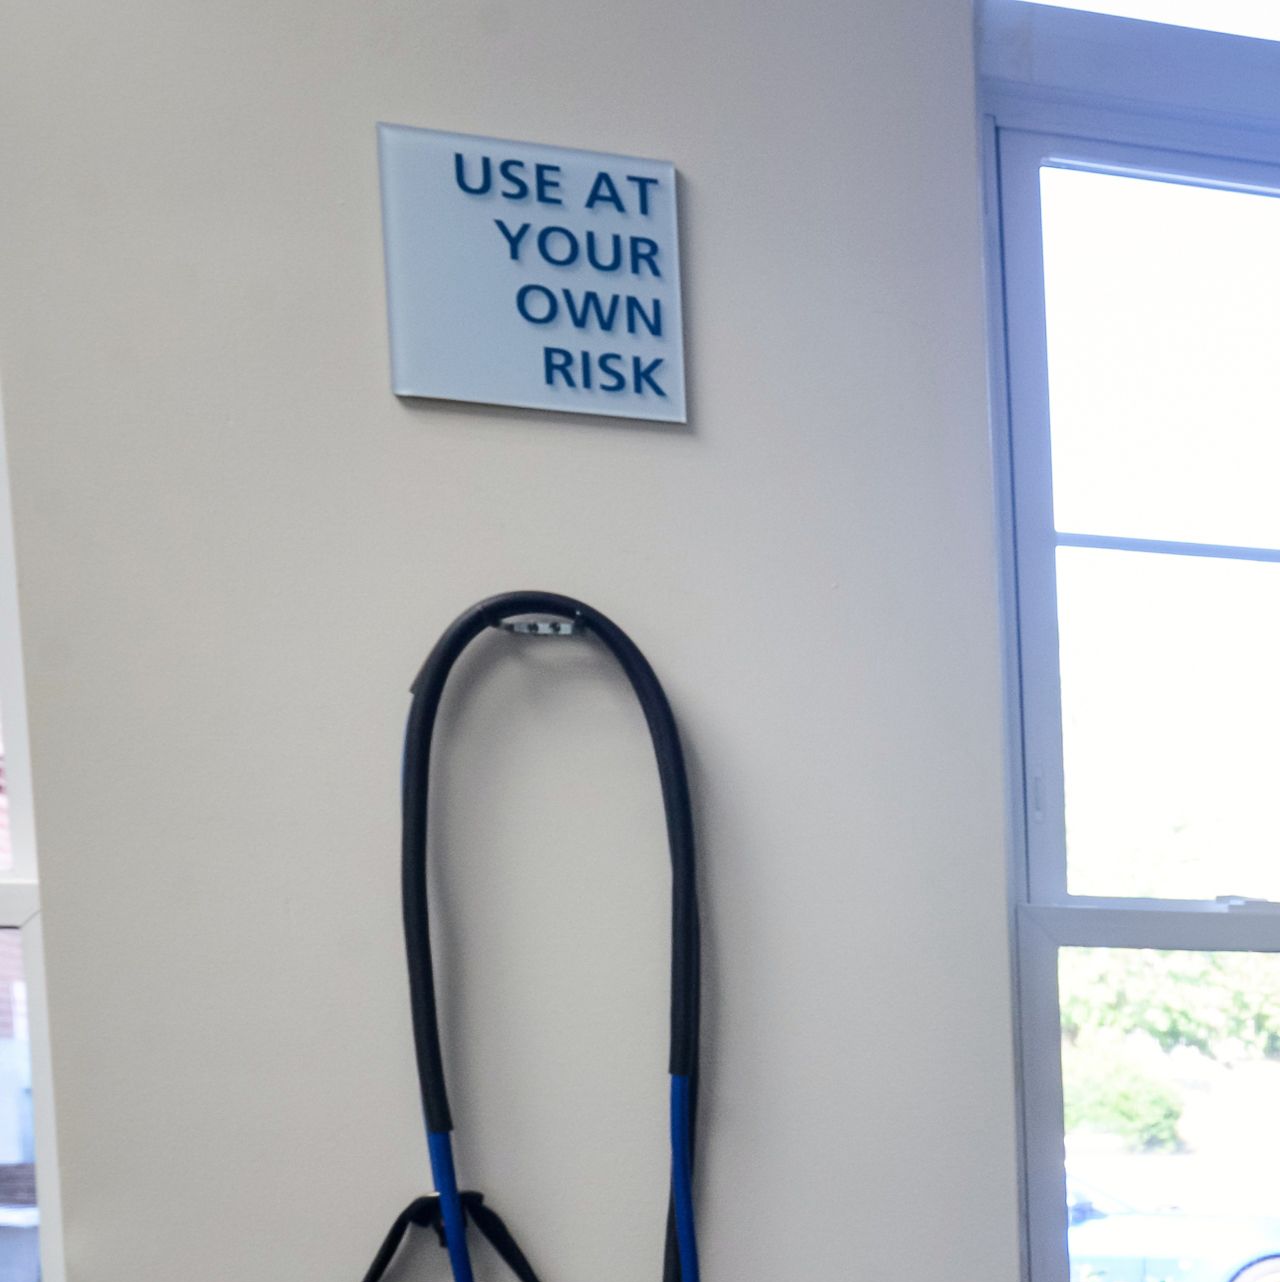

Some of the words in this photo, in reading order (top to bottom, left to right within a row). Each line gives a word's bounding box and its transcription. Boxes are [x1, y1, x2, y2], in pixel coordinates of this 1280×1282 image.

[454, 152, 563, 206] USE
[584, 171, 659, 217] AT
[493, 218, 662, 279] YOUR
[515, 283, 663, 338] OWN
[542, 346, 667, 398] RISK
